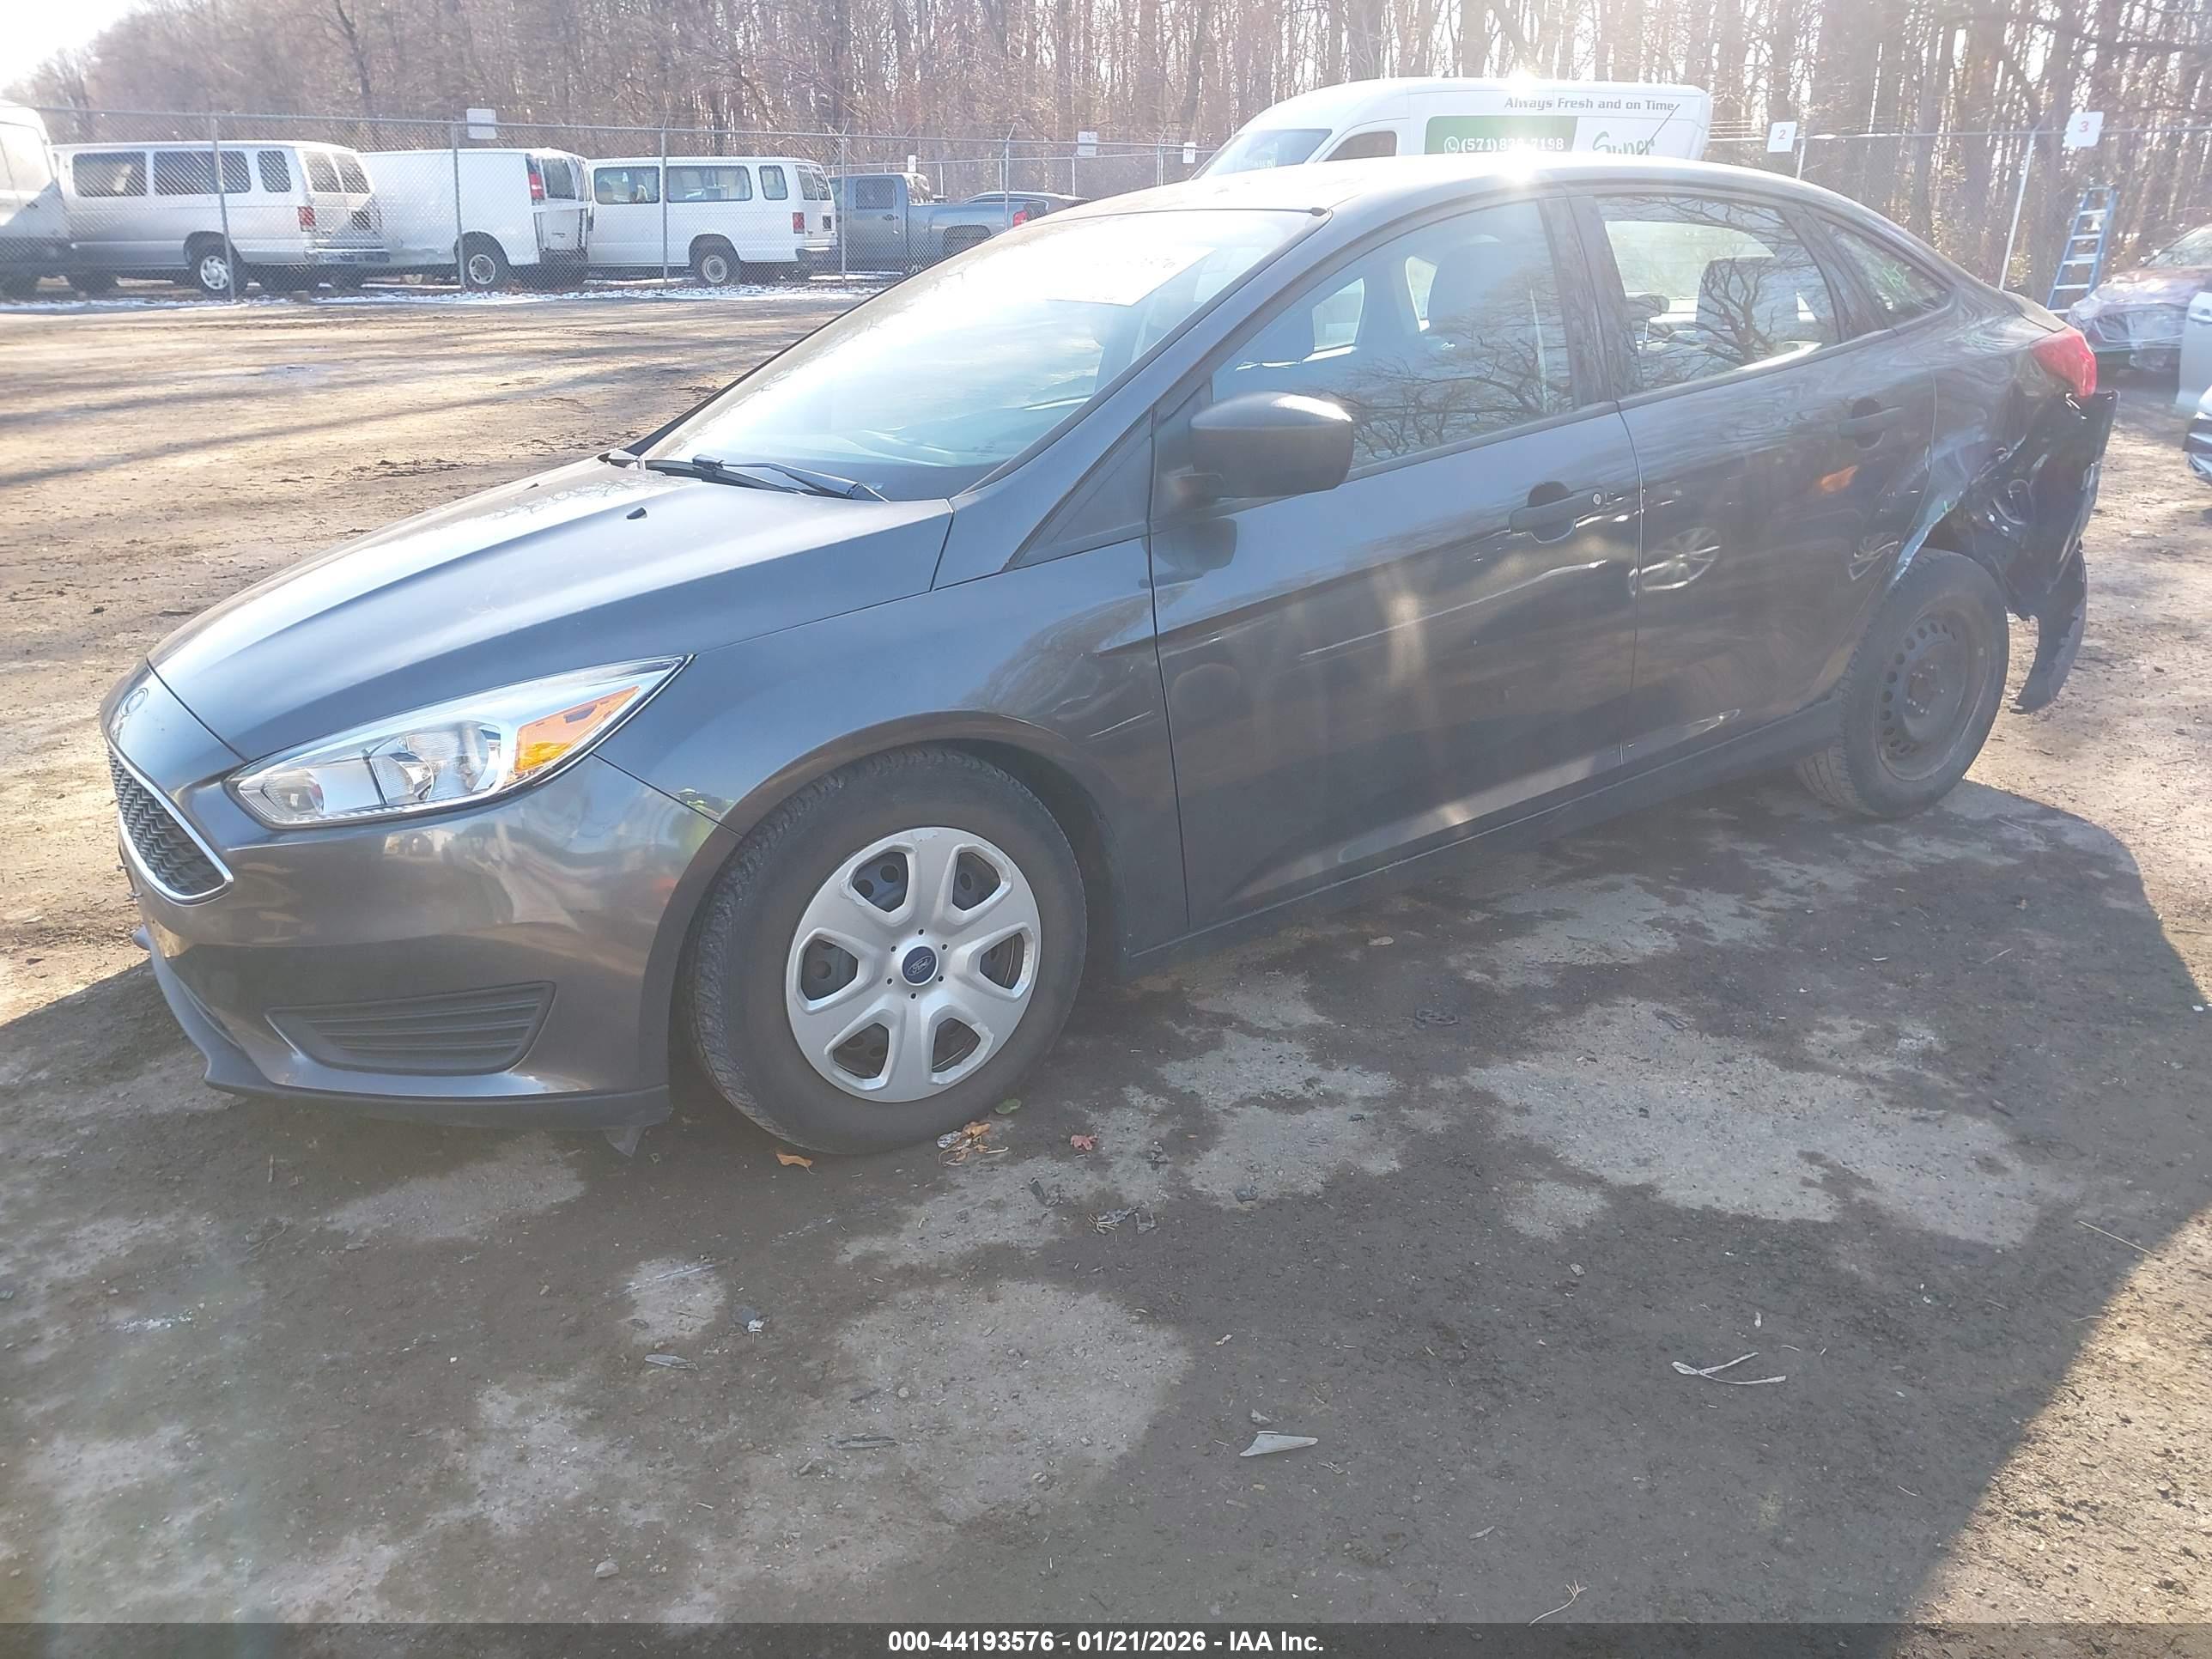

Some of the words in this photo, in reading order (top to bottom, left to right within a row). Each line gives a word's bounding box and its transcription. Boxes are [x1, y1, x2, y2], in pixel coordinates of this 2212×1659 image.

[1504, 96, 1553, 110] Always
[1558, 98, 1594, 109] Fresh
[1597, 100, 1622, 110] and
[1646, 100, 1675, 111] Time
[2079, 120, 2089, 133] 3
[1778, 129, 1787, 140] 2
